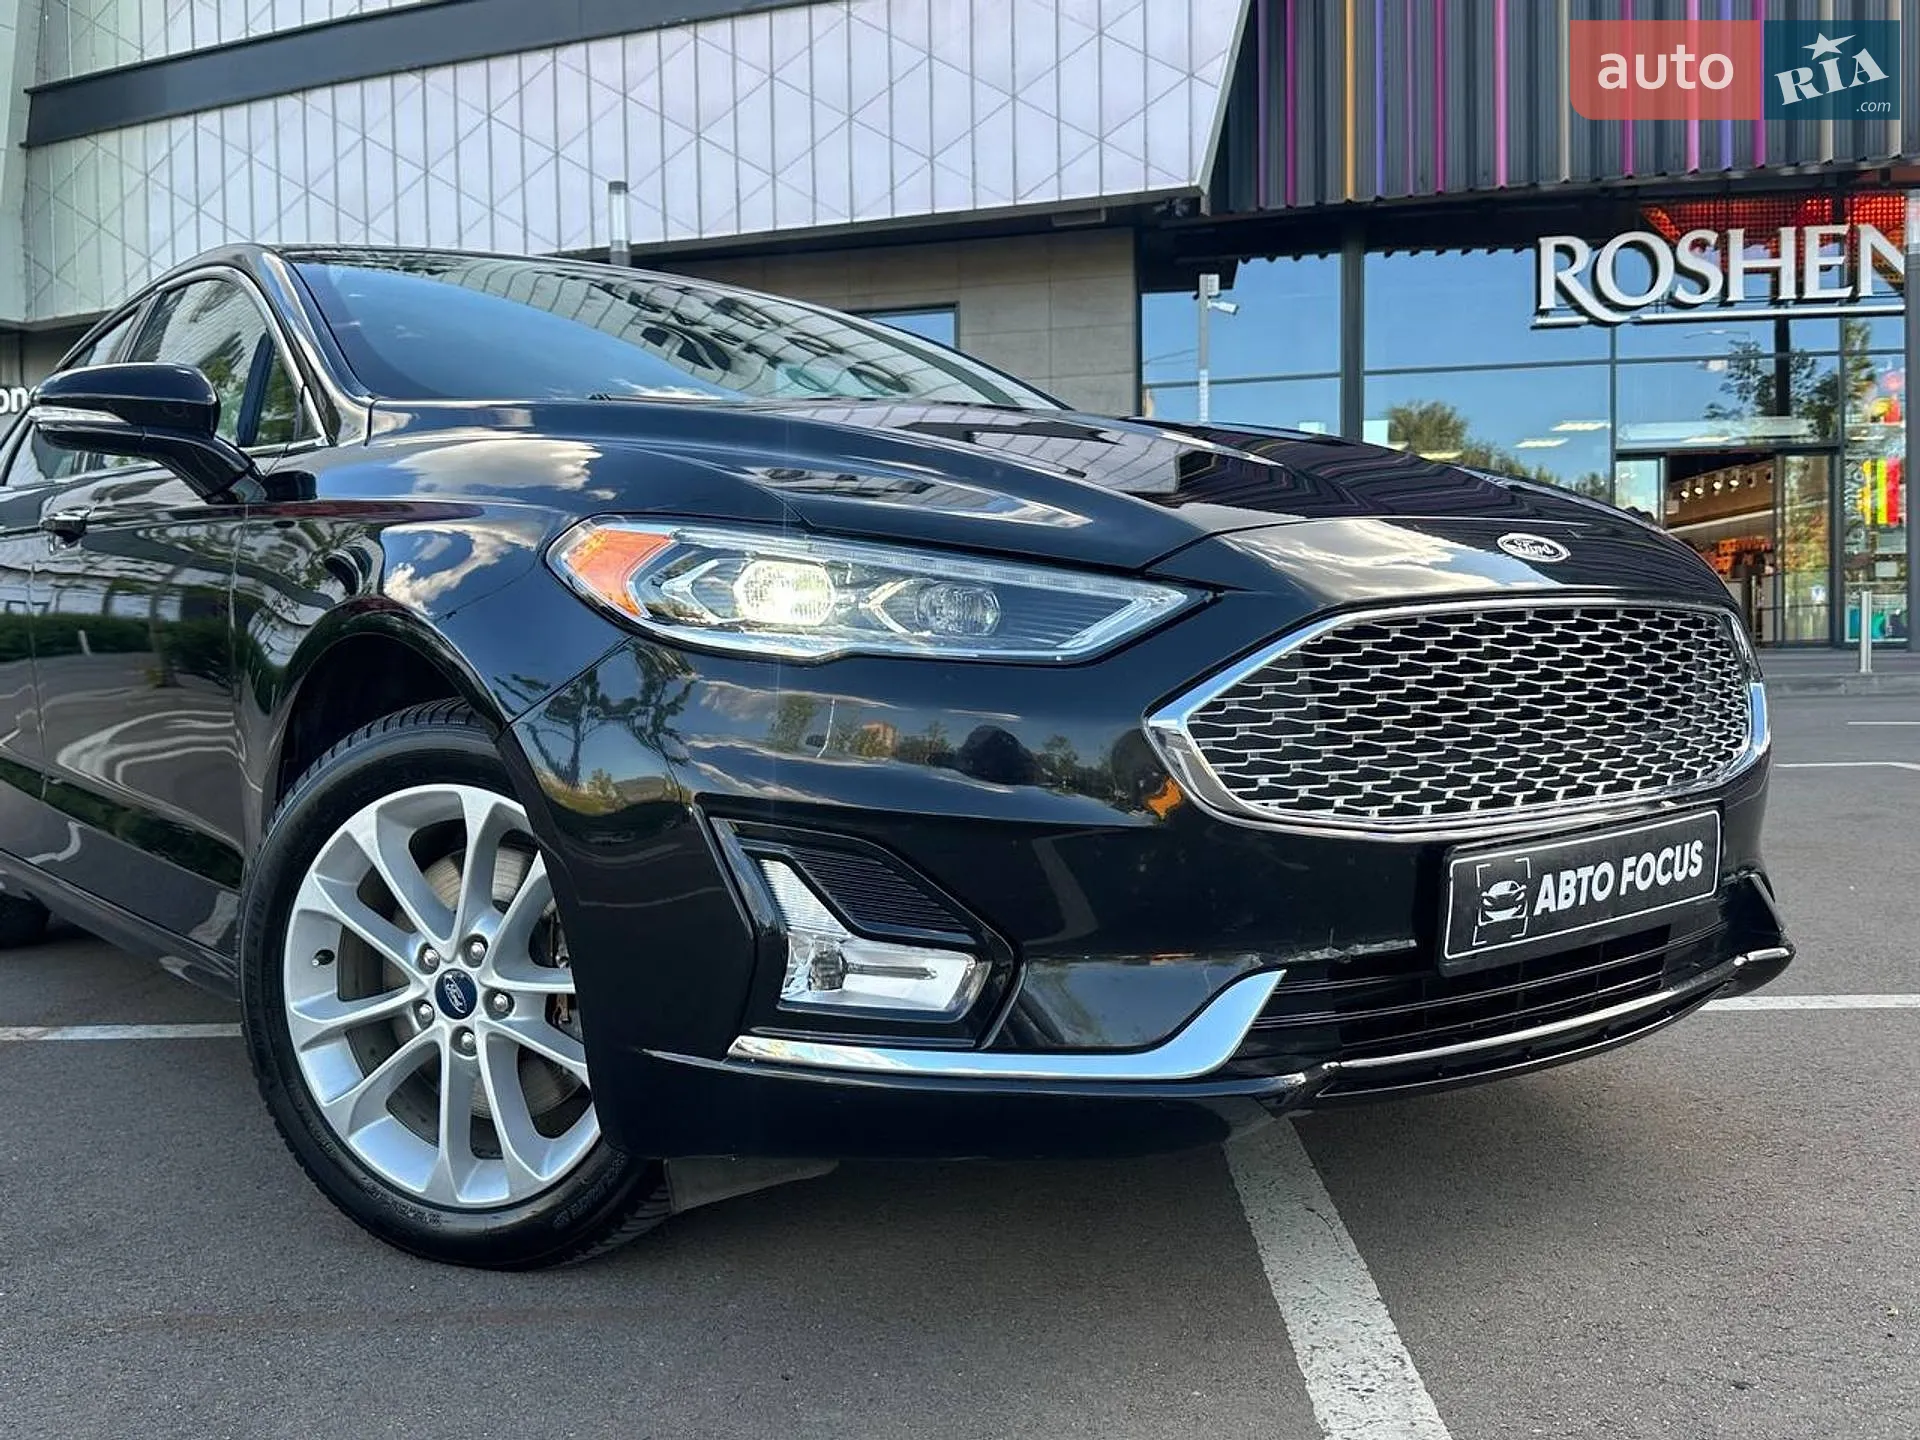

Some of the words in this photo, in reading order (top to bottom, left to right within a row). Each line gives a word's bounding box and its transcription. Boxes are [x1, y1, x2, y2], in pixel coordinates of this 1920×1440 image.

[1538, 223, 1905, 323] ROSHEN
[0, 386, 35, 414] on
[1619, 839, 1704, 896] FOCUS
